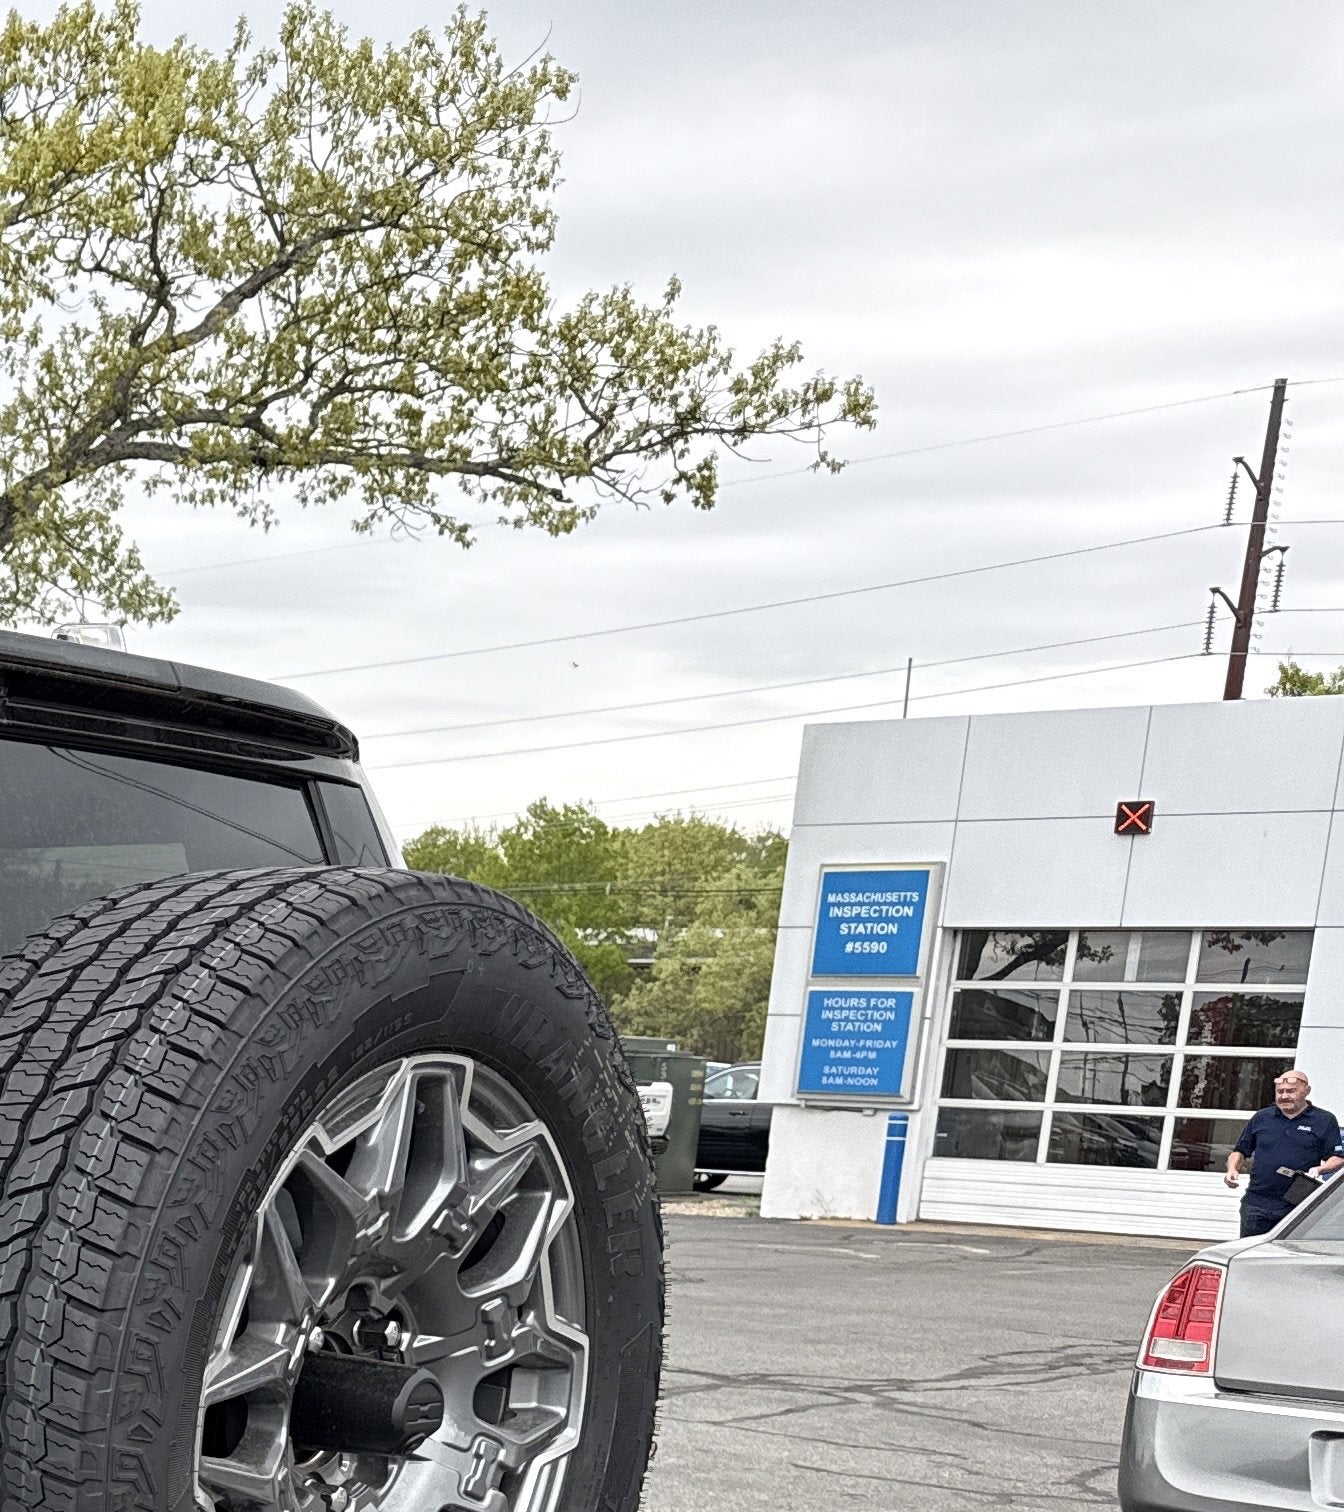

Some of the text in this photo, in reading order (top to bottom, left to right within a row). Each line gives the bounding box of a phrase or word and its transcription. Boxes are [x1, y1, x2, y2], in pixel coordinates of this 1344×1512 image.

[827, 892, 919, 903] MASSACHUSETTS
[829, 905, 914, 918] INSPECTION
[839, 922, 898, 935] STATION
[844, 941, 888, 953] #5590
[823, 997, 897, 1008] HOURS FOR
[821, 1009, 896, 1020] INSPECTION
[830, 1021, 883, 1032] STATION
[812, 1038, 899, 1049] MONDAY-FRIDAY
[822, 1065, 880, 1076] SATURDAY
